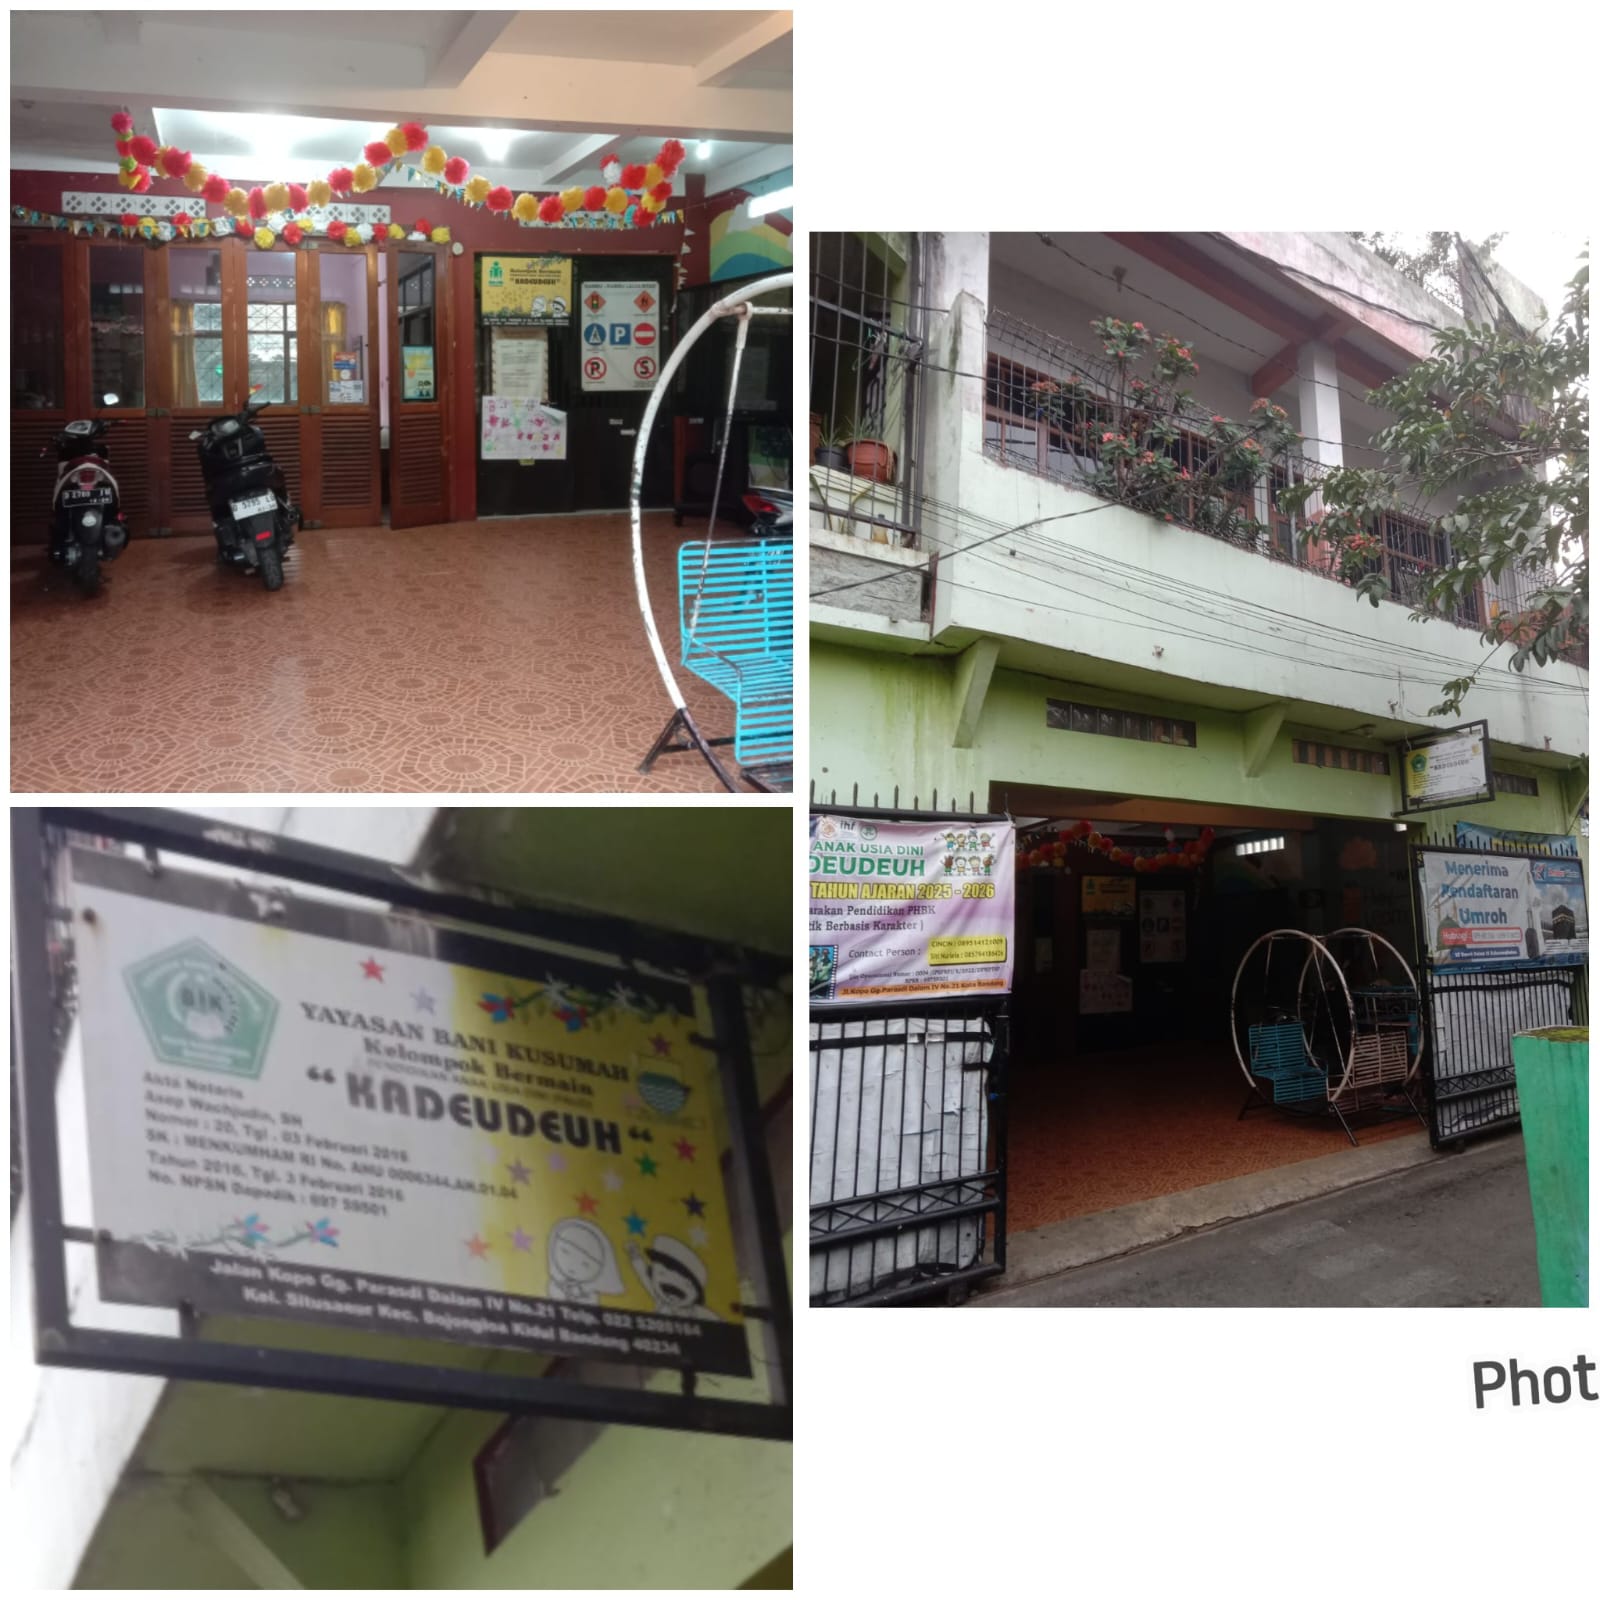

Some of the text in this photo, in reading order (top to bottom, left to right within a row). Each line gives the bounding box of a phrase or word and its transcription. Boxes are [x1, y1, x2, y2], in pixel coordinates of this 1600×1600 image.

[614, 323, 626, 342] P
[639, 360, 650, 375] S
[813, 841, 924, 856] ANAK USIA DINI
[1444, 860, 1509, 877] Menerima
[810, 882, 858, 899] TAHUN
[861, 883, 916, 900] AJARAN
[917, 883, 952, 899] 2025
[962, 882, 996, 899] 2026
[1440, 882, 1519, 900] Pendaftaran
[846, 904, 905, 916] Pendidikan
[907, 904, 937, 916] PHBK
[1458, 908, 1508, 924] Umroh
[825, 920, 871, 932] Berbasis
[873, 918, 918, 931] Karakter
[848, 949, 883, 959] Contact
[886, 947, 914, 958] Person
[300, 1001, 629, 1082] YAYASAN BANI KUSUMAH
[363, 1036, 595, 1096] Kelompok Bermain
[346, 1071, 623, 1155] KADEUDEUH
[305, 1133, 368, 1157] Februari
[299, 1172, 363, 1196] Februari
[209, 1258, 264, 1280] Jalan
[266, 1266, 317, 1288] Kopo
[426, 1286, 483, 1310] Dalam
[511, 1321, 556, 1340] Kidul
[558, 1328, 632, 1353] Bandung
